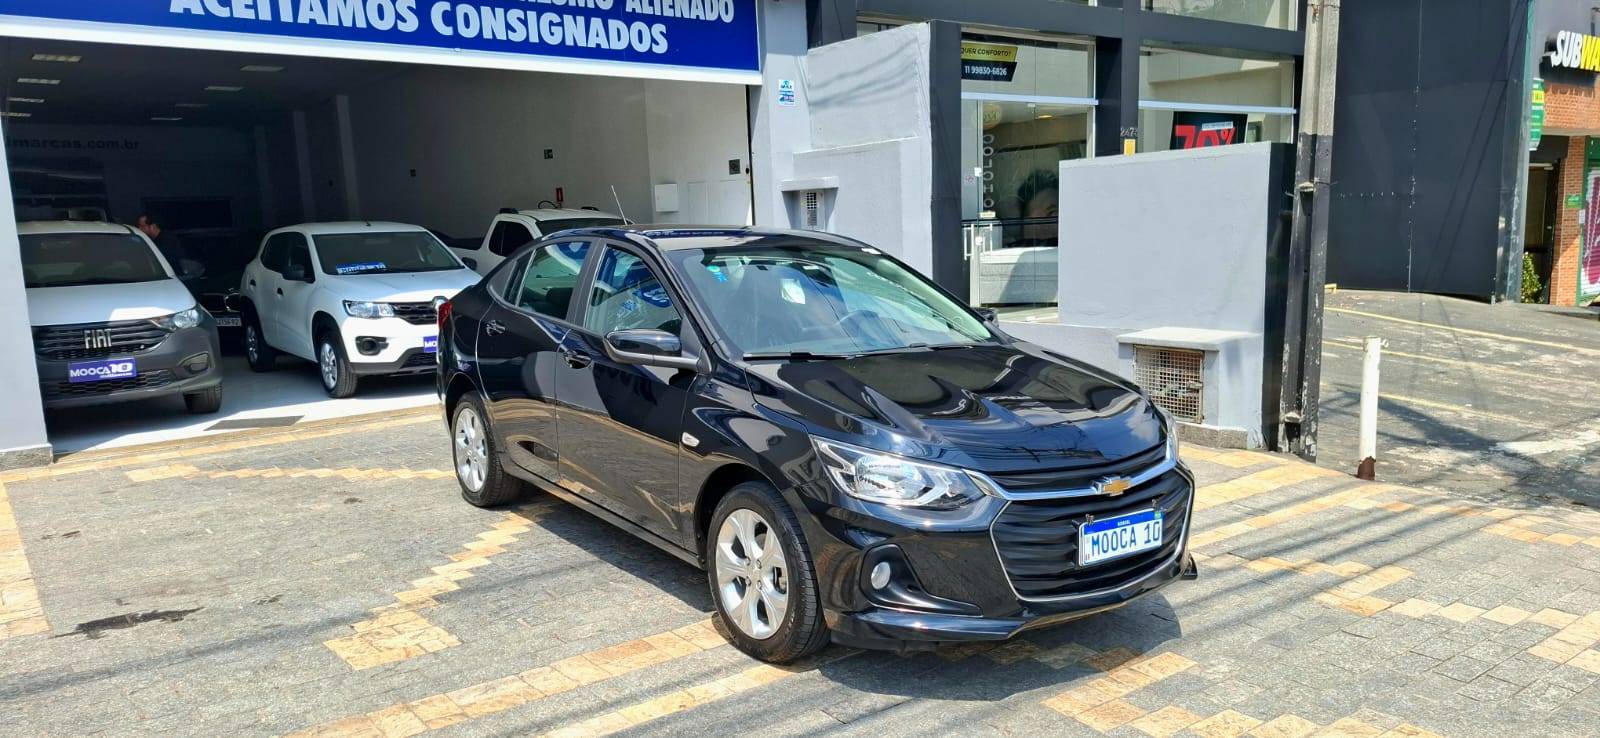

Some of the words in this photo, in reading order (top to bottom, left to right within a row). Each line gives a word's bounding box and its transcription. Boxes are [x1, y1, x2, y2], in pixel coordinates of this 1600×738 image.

[430, 2, 668, 54] CONSIGNADOS
[964, 65, 970, 74] 11
[1175, 125, 1237, 150] 70%
[84, 329, 111, 349] FIAT
[70, 366, 110, 378] MOOCA
[109, 362, 133, 373] 10
[1091, 526, 1137, 557] MOOCA
[1144, 521, 1161, 545] 10
